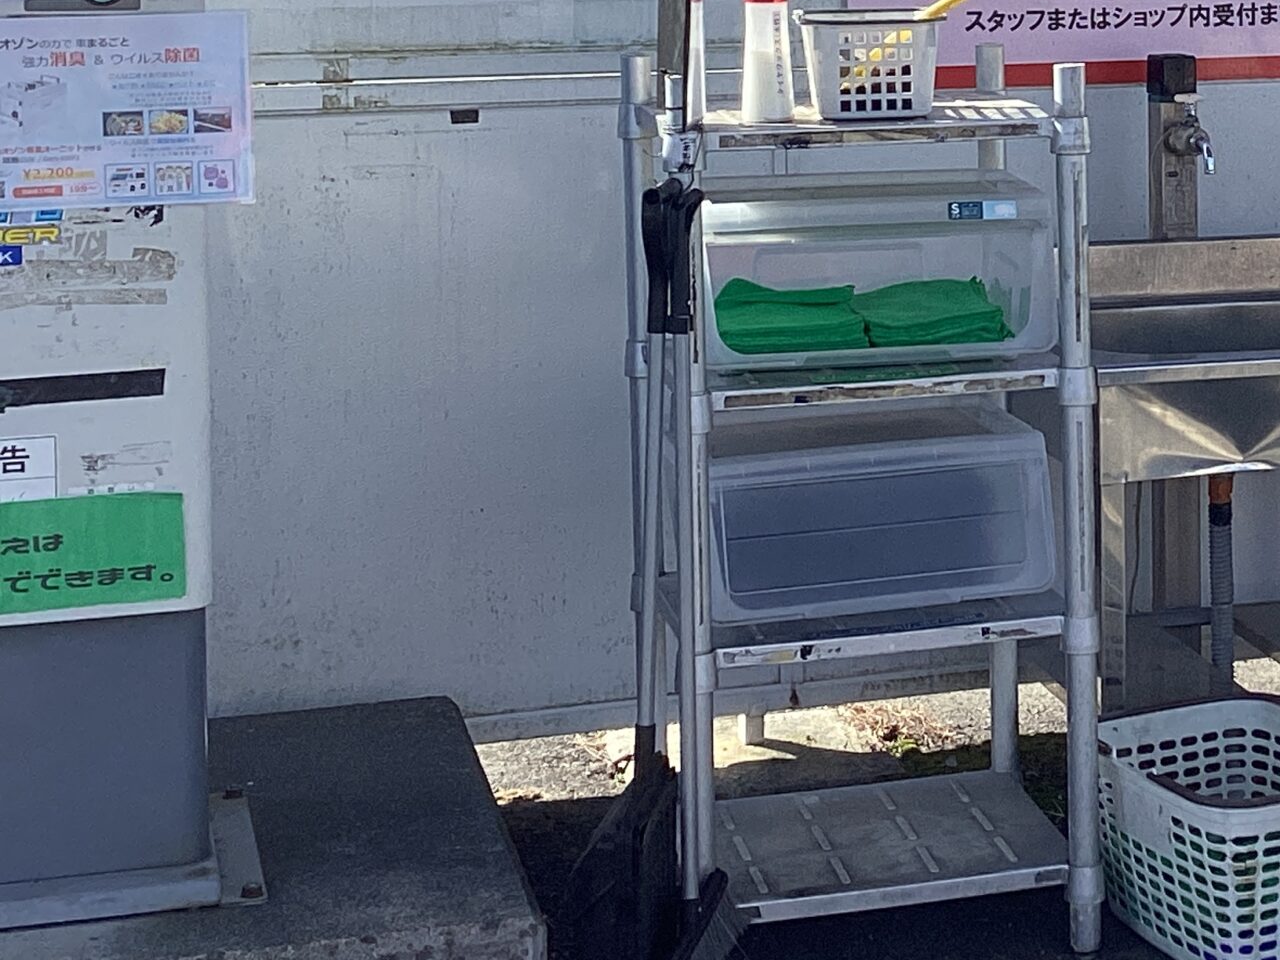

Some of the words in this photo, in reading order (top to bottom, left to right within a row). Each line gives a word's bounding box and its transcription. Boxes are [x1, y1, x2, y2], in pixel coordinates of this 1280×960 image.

[0, 225, 61, 245] ER
[3, 563, 175, 594] でできます。
